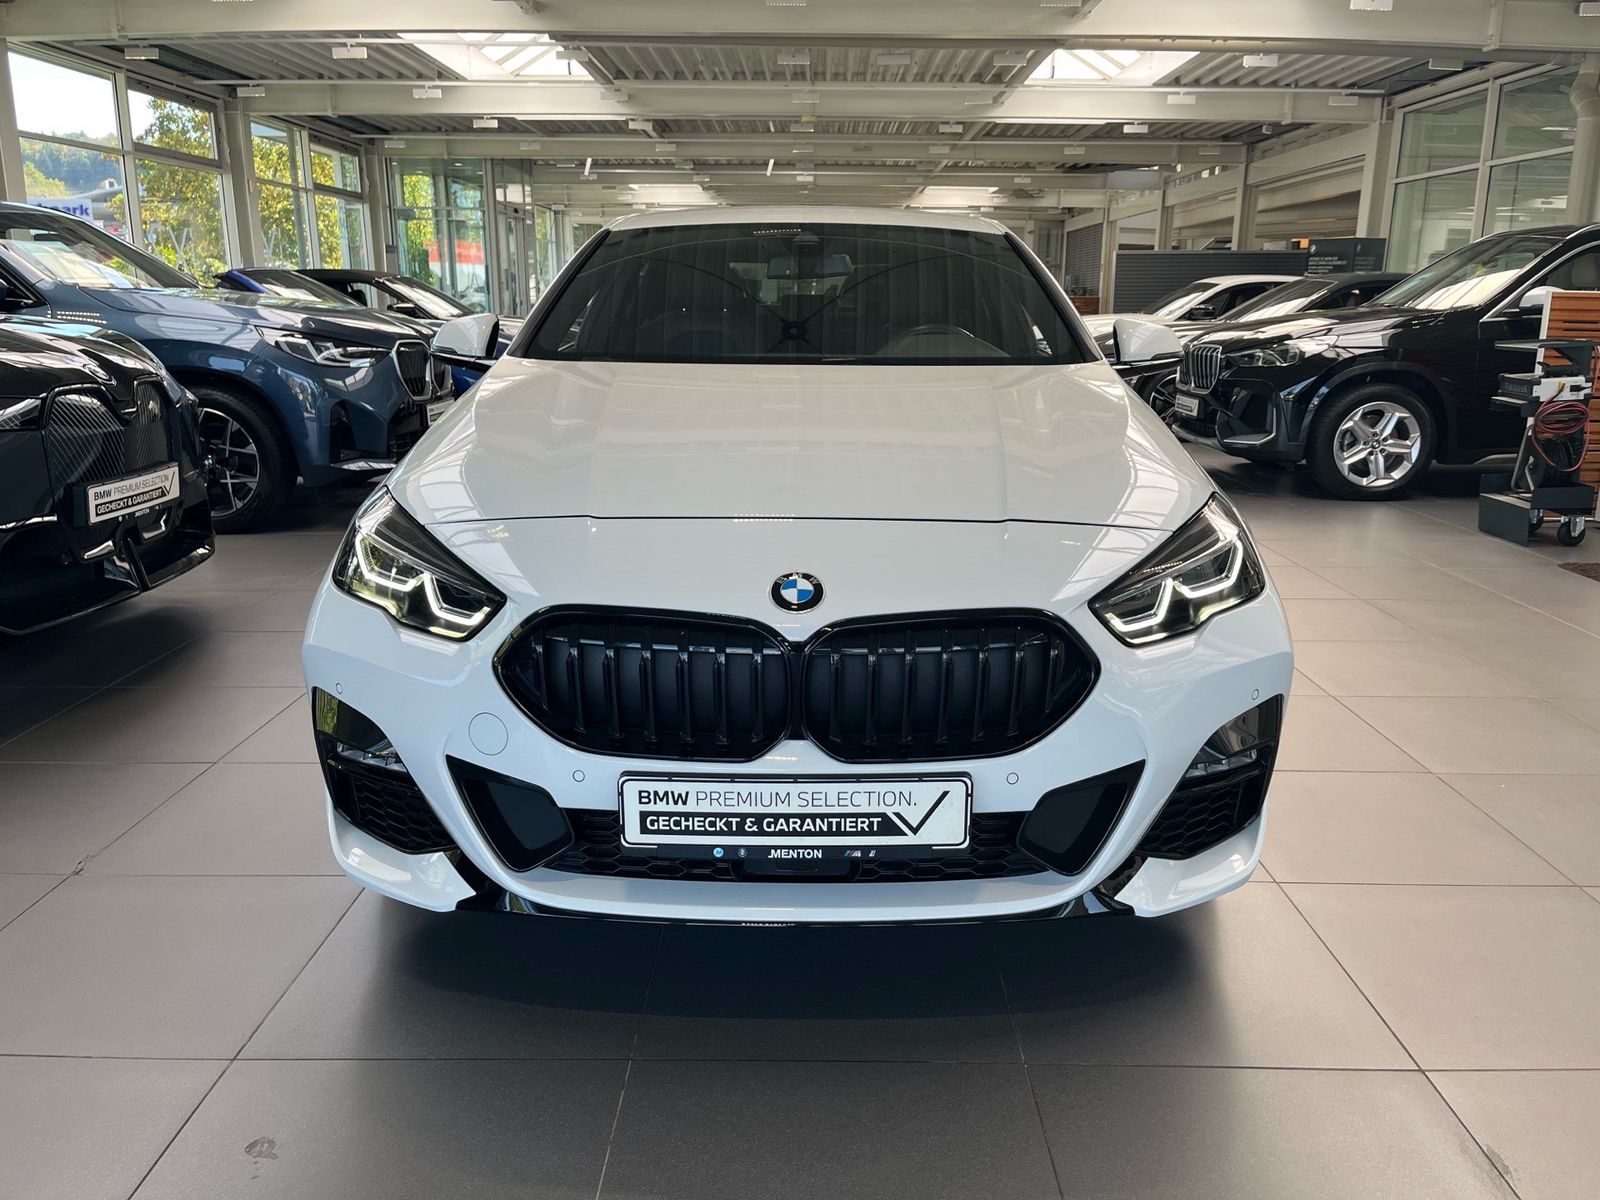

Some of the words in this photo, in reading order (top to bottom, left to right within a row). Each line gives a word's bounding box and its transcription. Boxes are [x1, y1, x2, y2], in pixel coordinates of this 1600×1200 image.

[93, 489, 112, 501] BMW
[114, 483, 141, 496] PREMIUM
[97, 500, 127, 514] GECHECKT
[638, 790, 689, 806] BMW
[696, 791, 791, 807] PREMIUM
[797, 791, 917, 807] SELECTION.
[646, 816, 740, 831] GECHECKT
[744, 818, 758, 832] &
[762, 817, 882, 832] GARANTIERT
